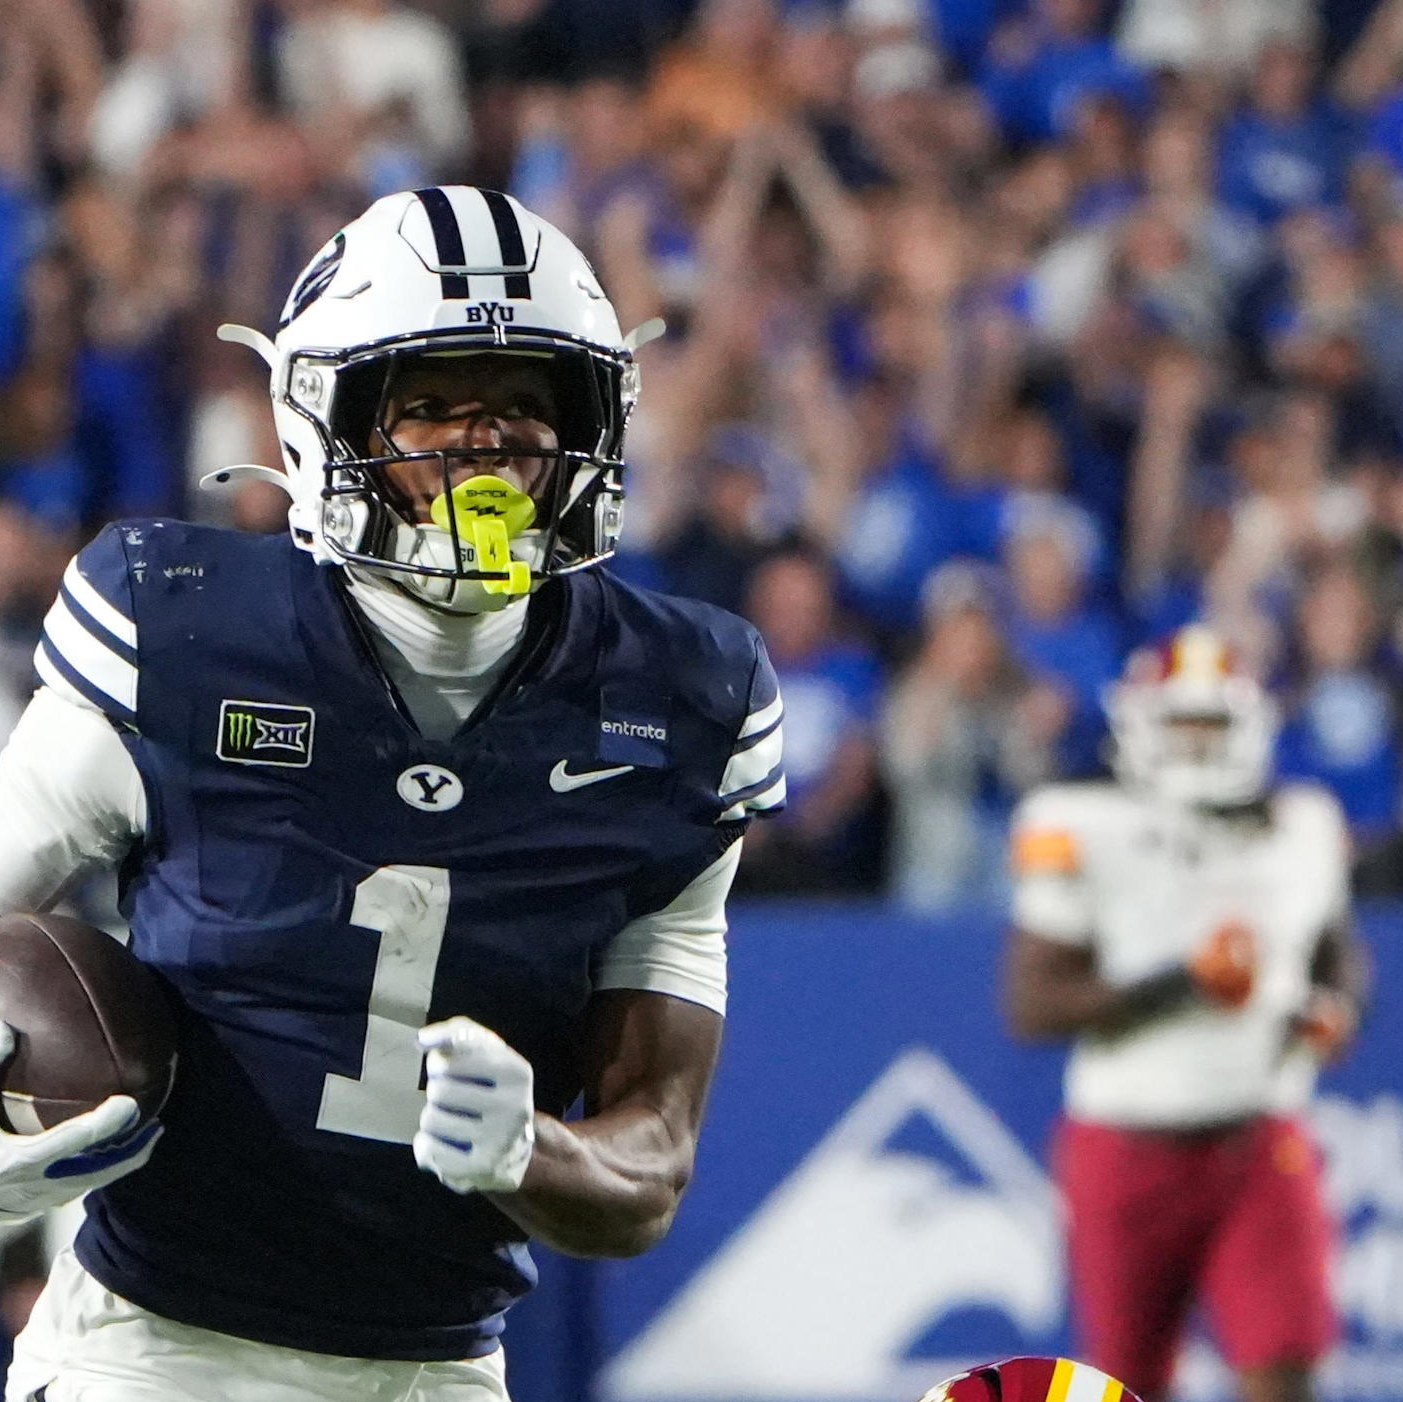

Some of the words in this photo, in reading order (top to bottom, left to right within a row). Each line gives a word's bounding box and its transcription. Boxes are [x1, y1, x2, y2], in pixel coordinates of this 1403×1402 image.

[466, 302, 514, 325] BYU
[601, 720, 666, 741] entrata
[411, 771, 452, 804] Y
[316, 864, 450, 1145] 1
